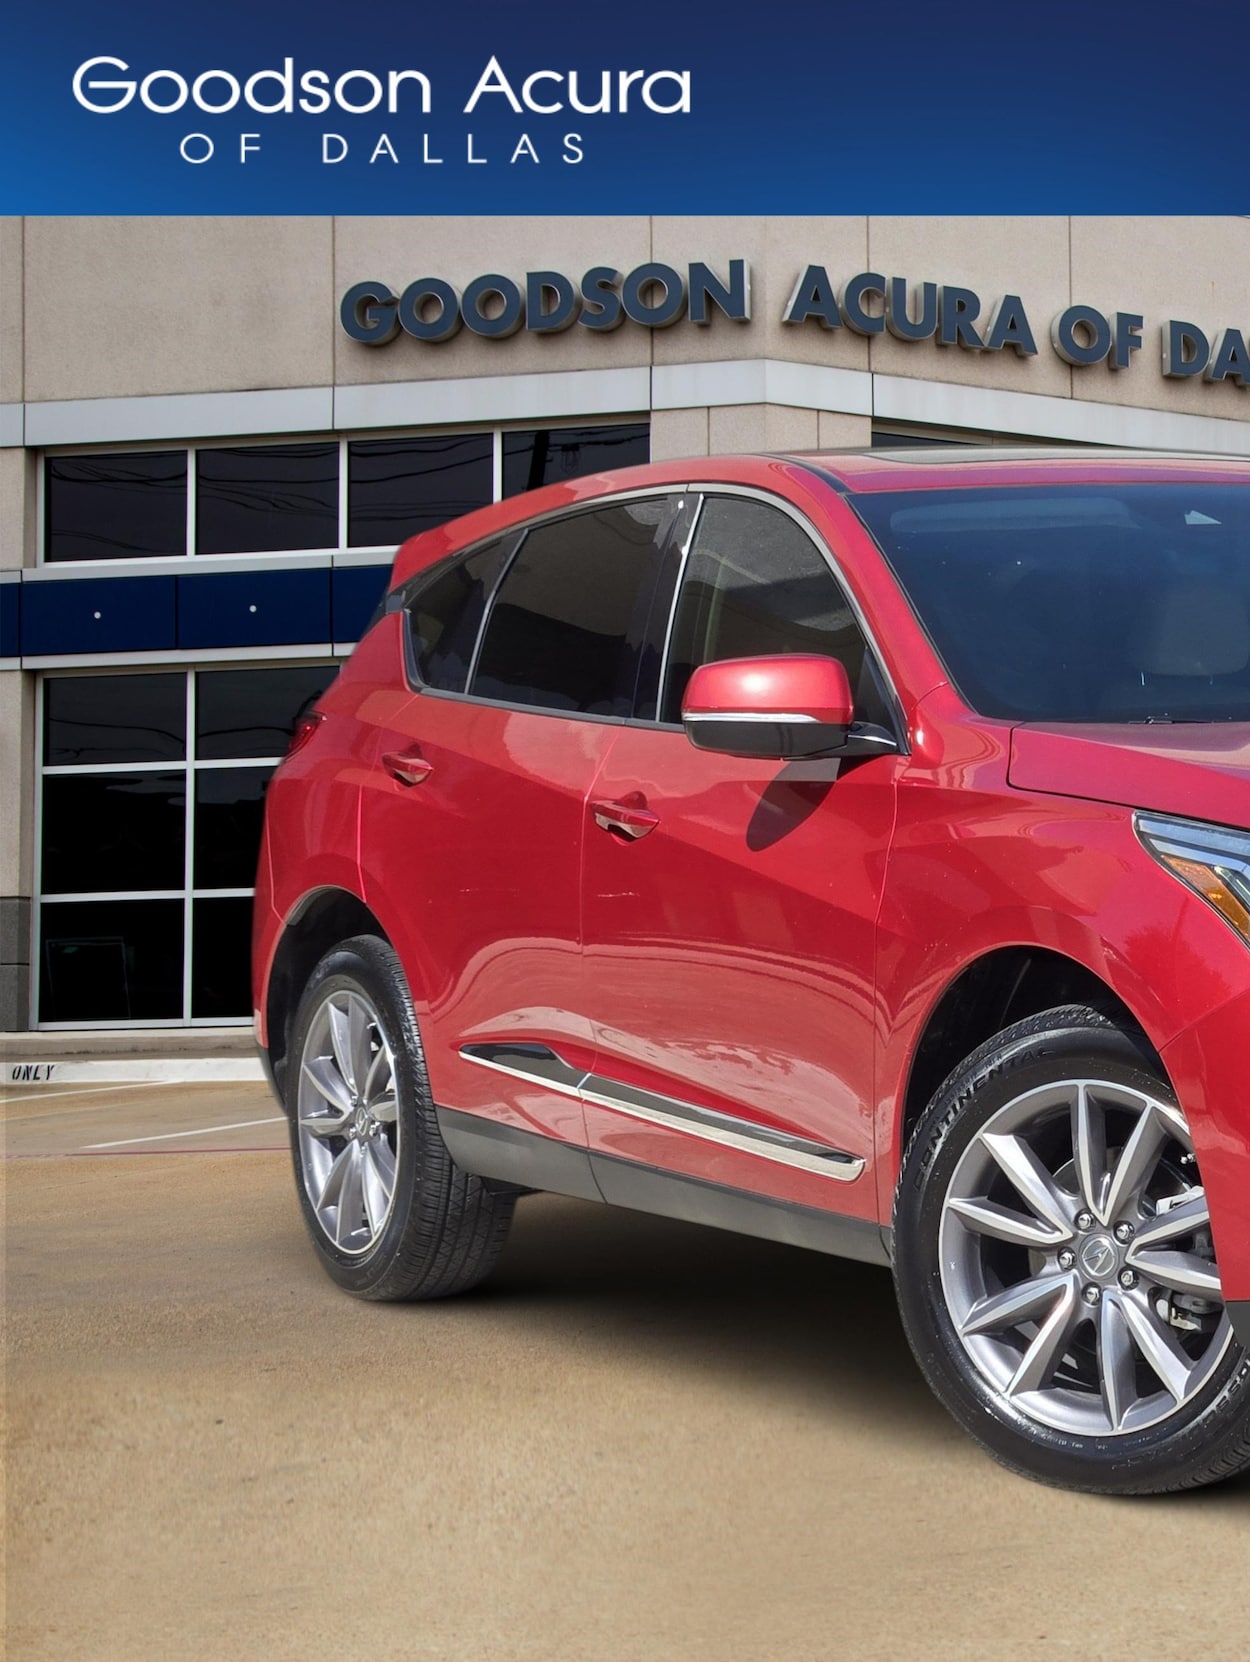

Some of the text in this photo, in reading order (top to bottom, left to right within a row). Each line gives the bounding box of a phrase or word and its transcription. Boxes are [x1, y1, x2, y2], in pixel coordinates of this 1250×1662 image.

[340, 259, 750, 346] GOODSON
[783, 264, 1038, 356] ACURA
[1052, 305, 1144, 370] OF
[11, 1065, 55, 1081] ONLY
